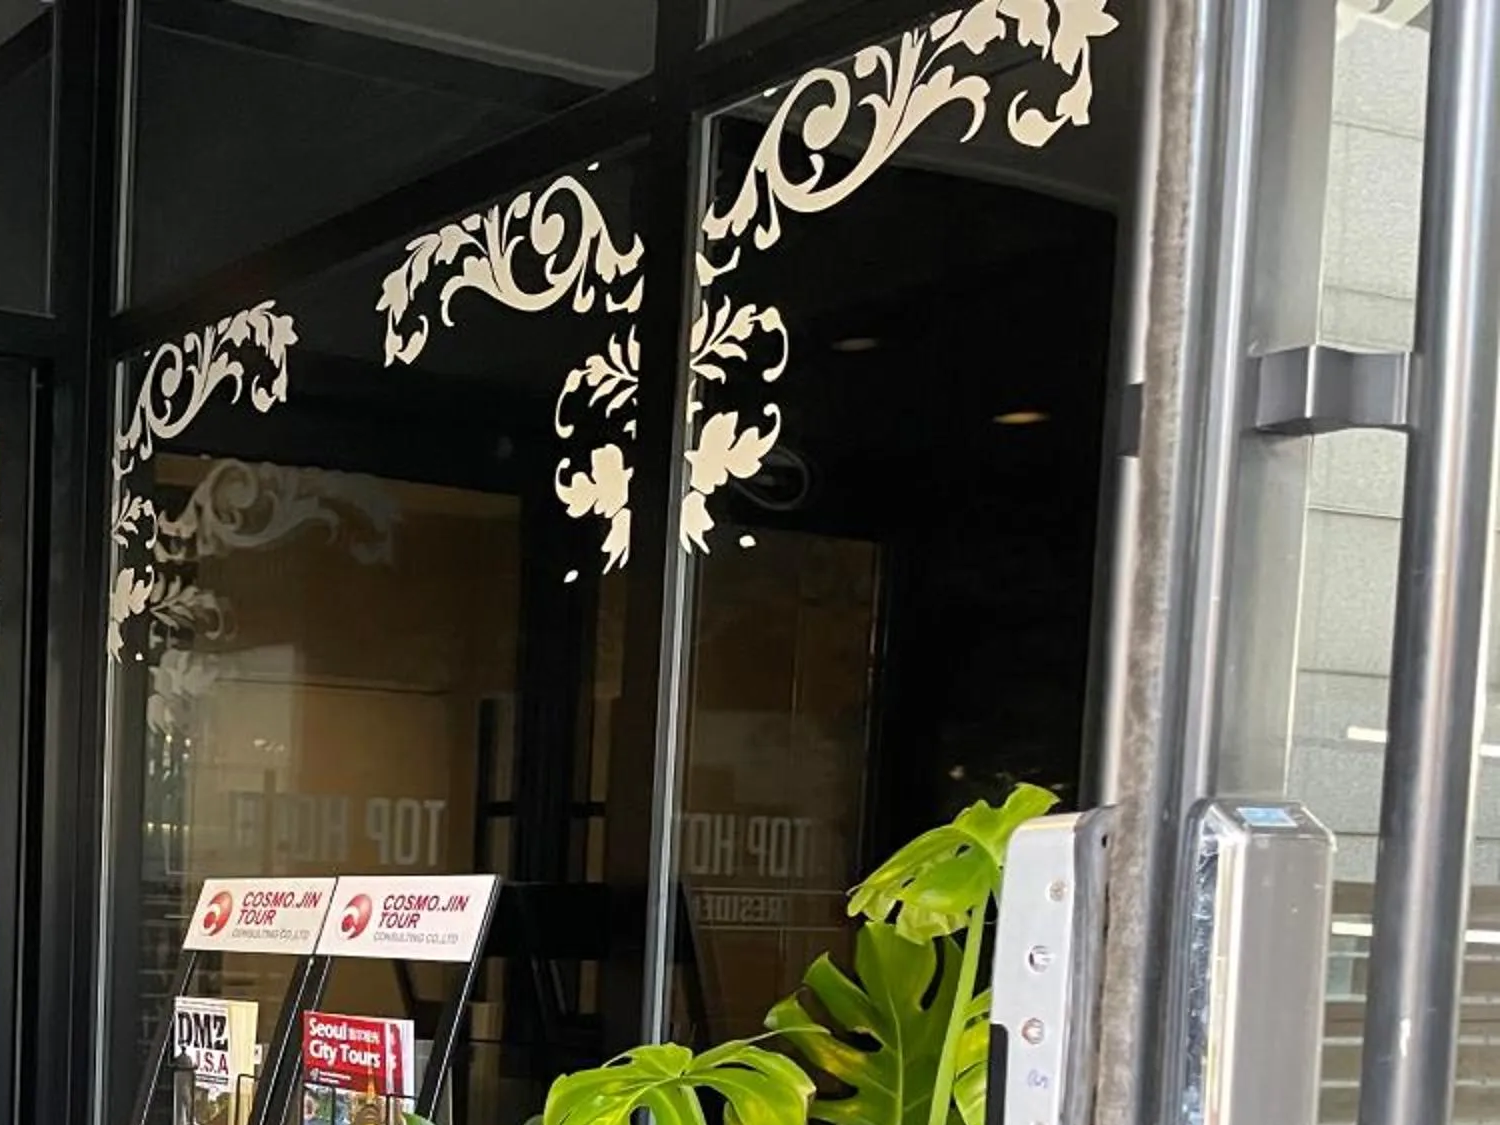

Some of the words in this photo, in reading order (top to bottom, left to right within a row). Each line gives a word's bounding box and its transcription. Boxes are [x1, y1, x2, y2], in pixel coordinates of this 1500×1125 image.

[242, 891, 323, 909] COSMO.JIN
[382, 894, 469, 912] COSMO.JIN
[237, 909, 276, 925] TOUR
[378, 913, 421, 929] TOUR
[309, 1018, 347, 1041] Seoul
[309, 1040, 338, 1066] City
[339, 1044, 381, 1069] Tours
